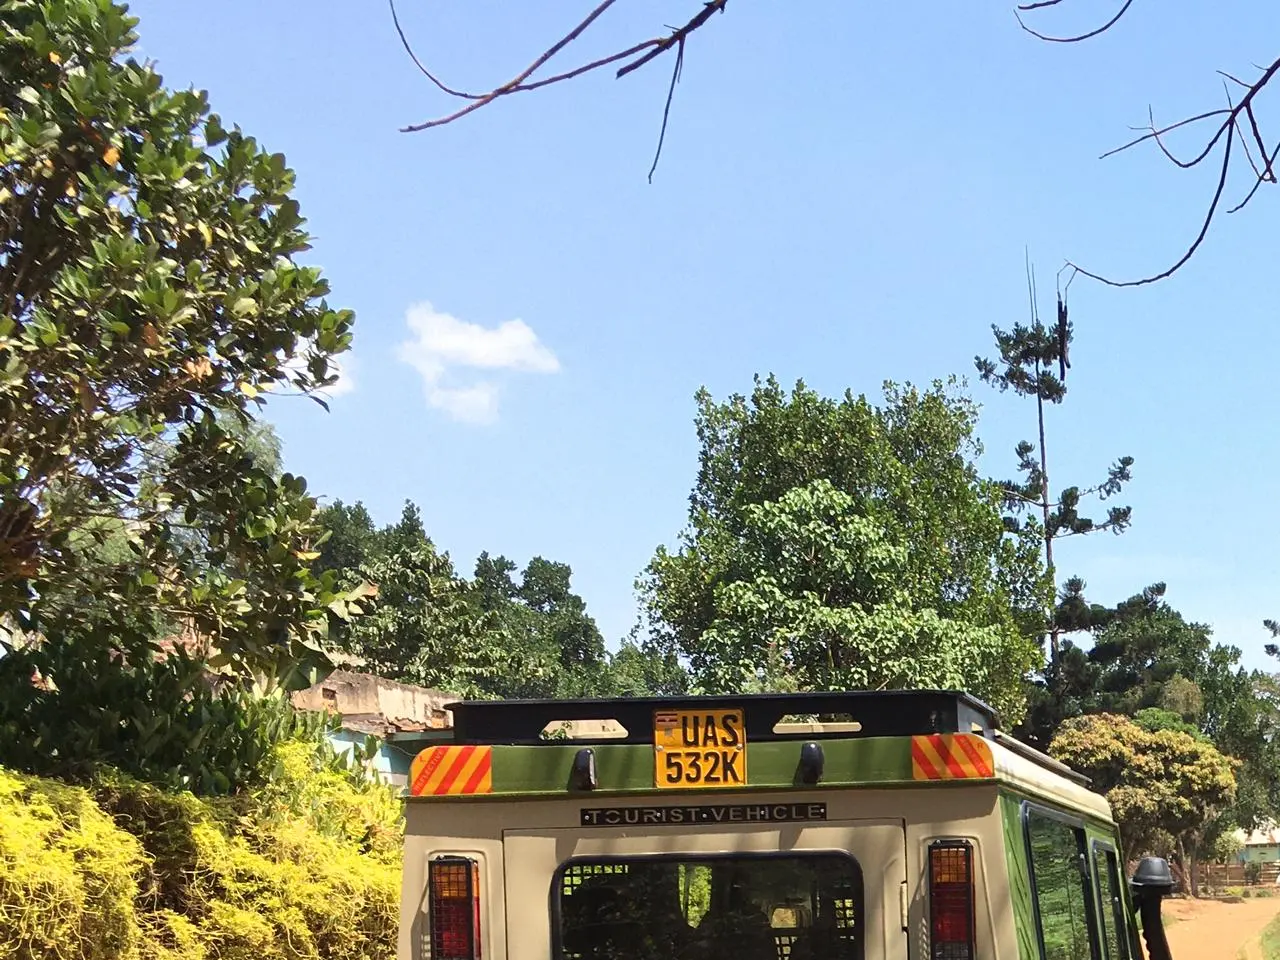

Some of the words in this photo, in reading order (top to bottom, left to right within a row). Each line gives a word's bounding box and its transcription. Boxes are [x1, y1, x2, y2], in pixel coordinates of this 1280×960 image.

[681, 714, 739, 748] UAS
[666, 751, 741, 784] 532K
[588, 807, 700, 825] TOURIST
[710, 804, 824, 821] VEHICLE
